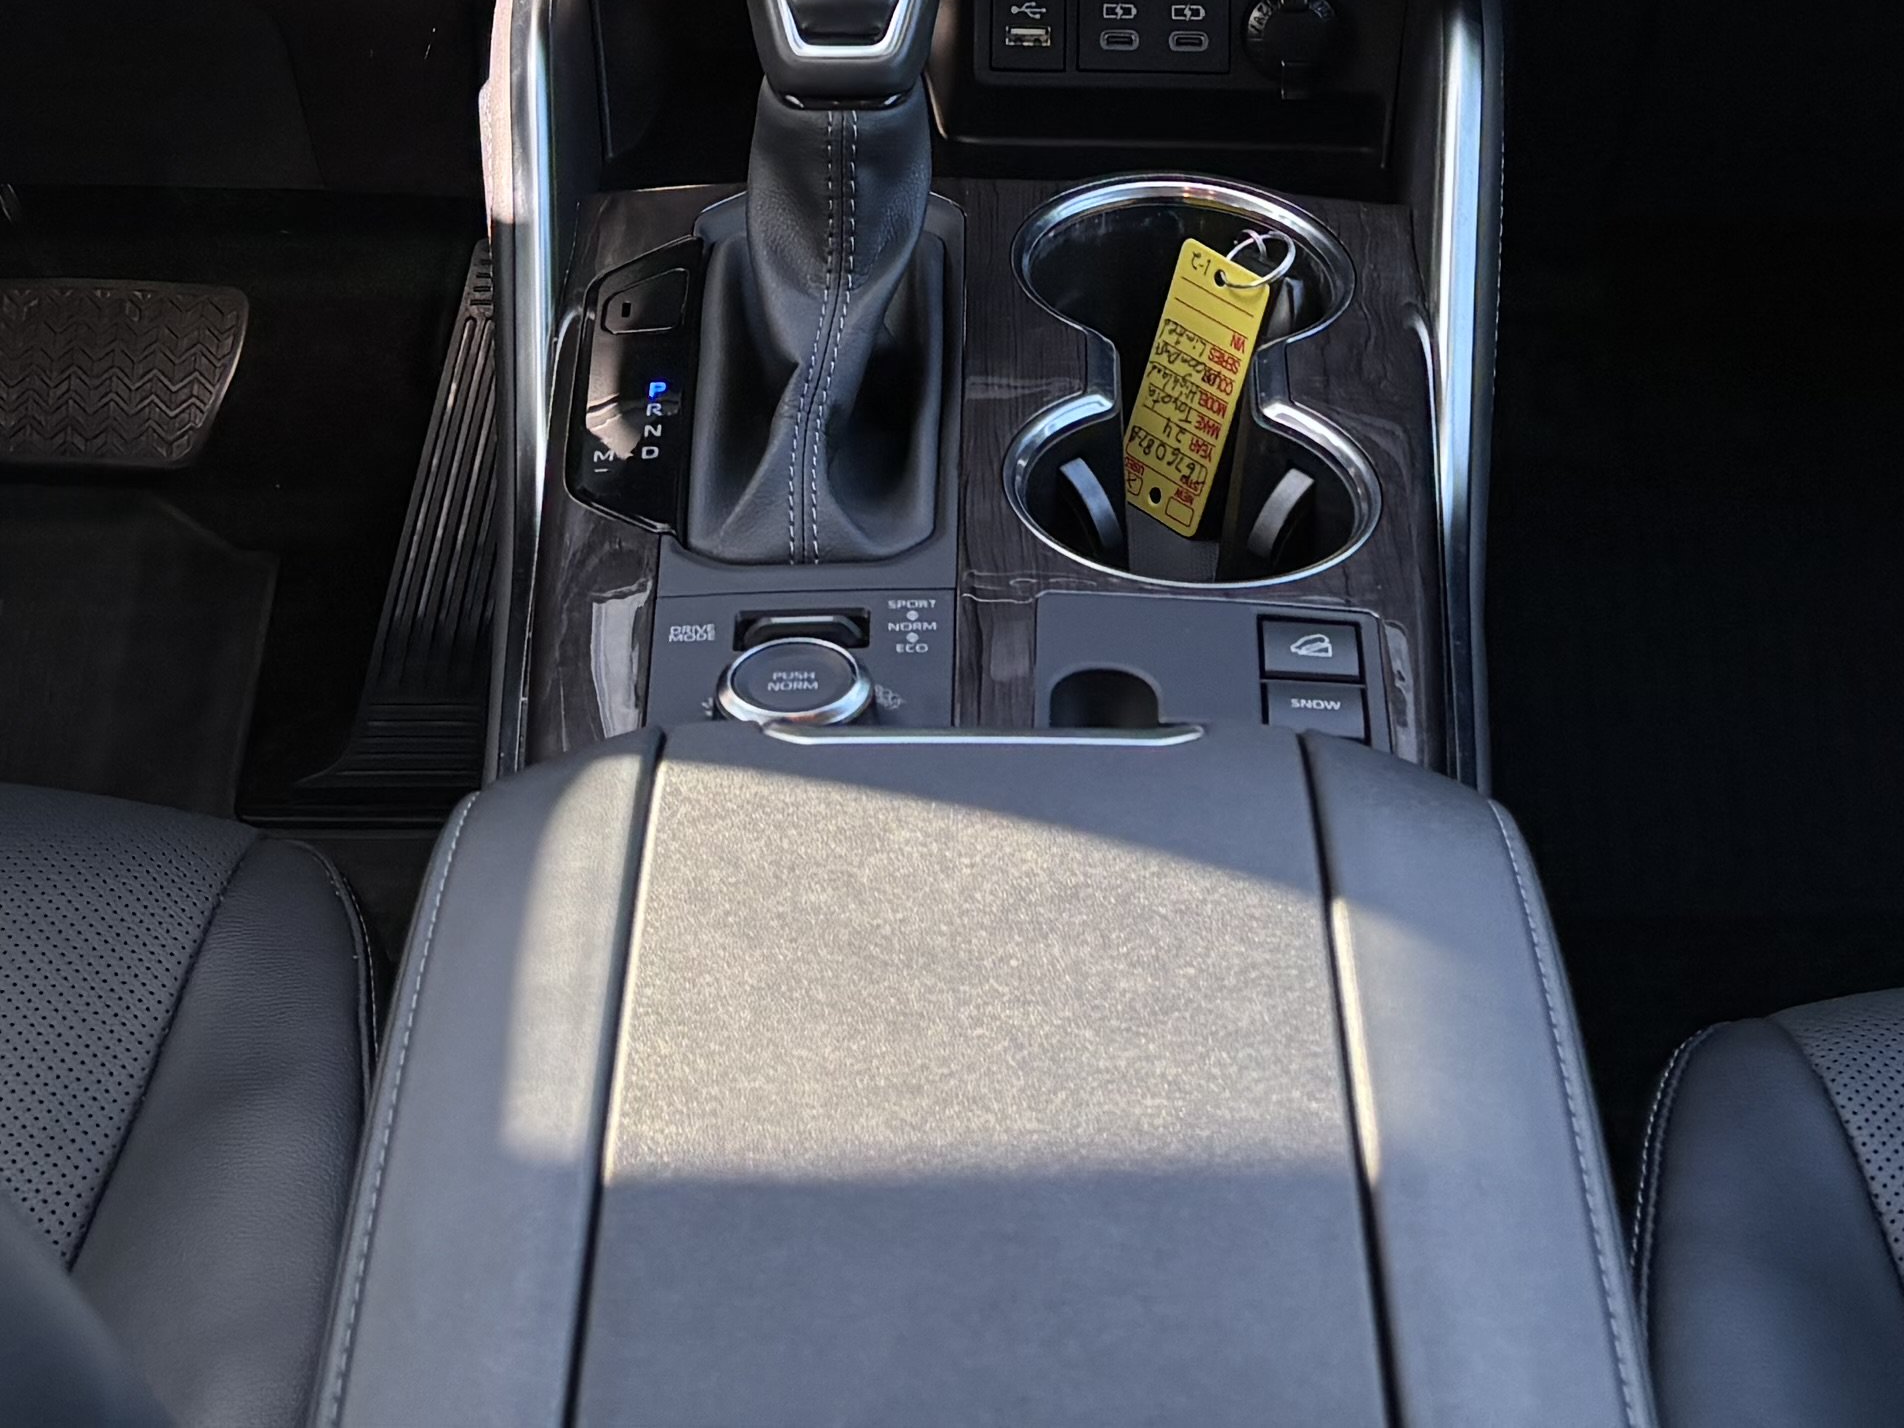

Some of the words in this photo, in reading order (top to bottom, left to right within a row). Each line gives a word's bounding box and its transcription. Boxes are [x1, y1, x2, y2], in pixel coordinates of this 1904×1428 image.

[1230, 332, 1248, 354] VIN
[1208, 346, 1241, 372] SERIES
[649, 382, 667, 398] P
[646, 403, 663, 416] R
[1149, 383, 1194, 424] Toyota
[1197, 391, 1228, 418] MODEL
[644, 424, 662, 438] N
[1162, 420, 1188, 438] 24
[1195, 414, 1220, 440] MAKE
[594, 450, 615, 462] M
[641, 446, 659, 459] D
[1188, 438, 1214, 462] YEAR
[1174, 487, 1197, 506] NEW
[887, 599, 937, 609] SPORT
[669, 624, 715, 634] DRIVE
[887, 621, 937, 631] NORM
[668, 632, 715, 642] MODE
[896, 643, 929, 653] ECO
[772, 671, 816, 680] PUSH
[767, 680, 819, 692] NORM
[1290, 698, 1341, 710] SNOW
